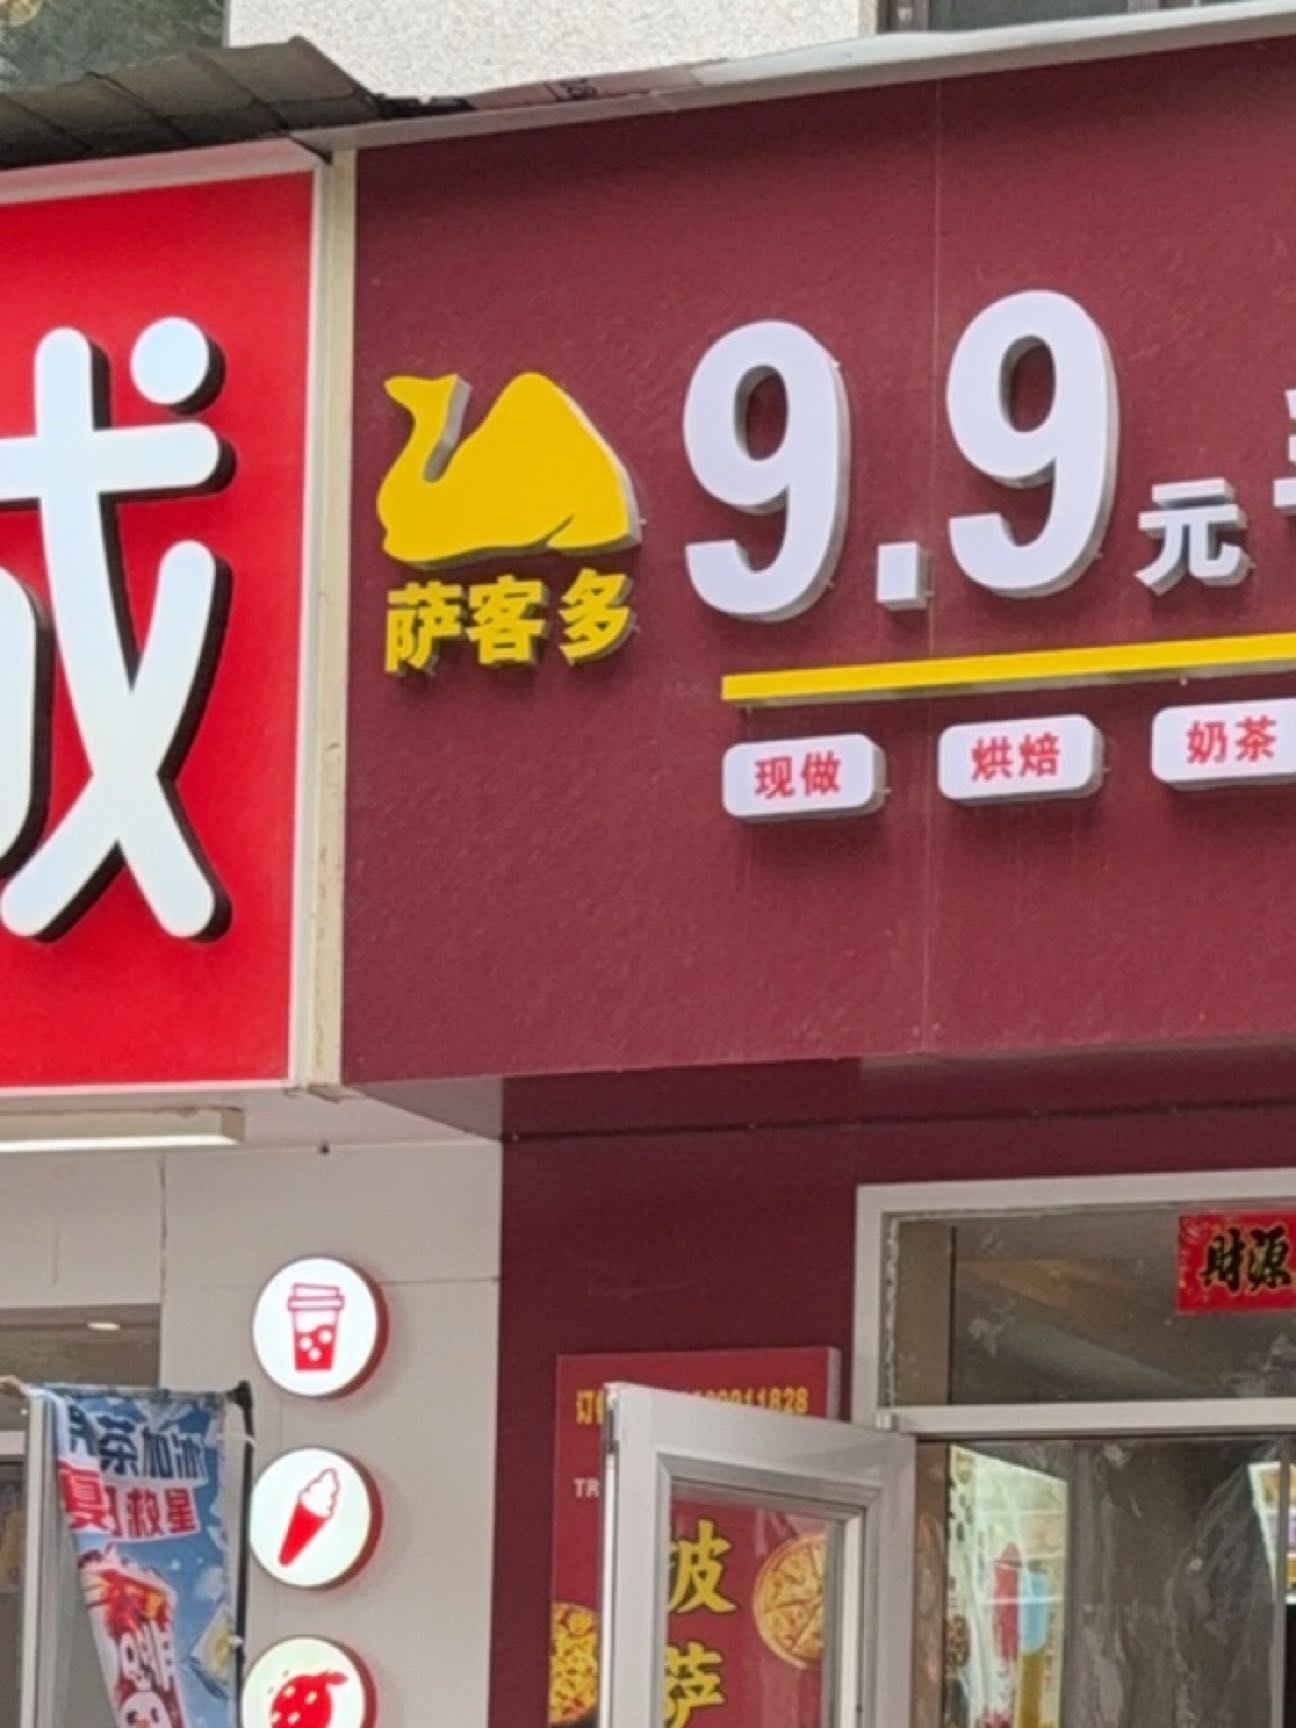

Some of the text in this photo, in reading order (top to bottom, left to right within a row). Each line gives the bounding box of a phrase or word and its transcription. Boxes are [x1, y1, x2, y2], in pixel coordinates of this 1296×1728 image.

[384, 569, 634, 675] 萨客多
[970, 731, 1062, 782] 烘焙
[1185, 716, 1278, 764] 奶茶
[753, 747, 841, 800] 现做
